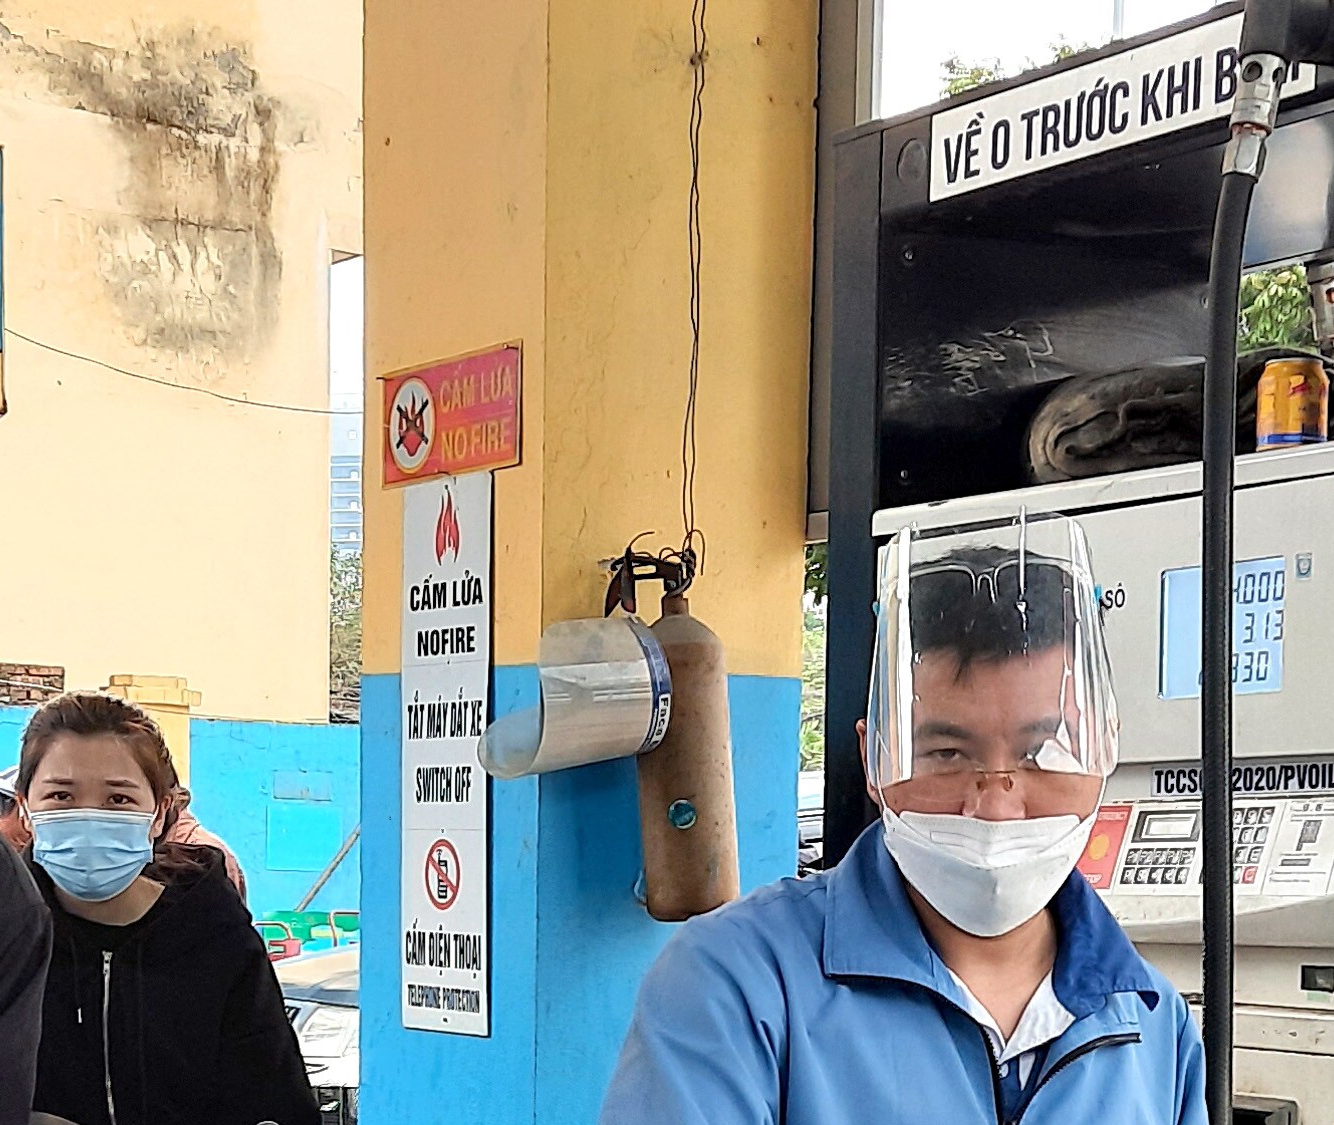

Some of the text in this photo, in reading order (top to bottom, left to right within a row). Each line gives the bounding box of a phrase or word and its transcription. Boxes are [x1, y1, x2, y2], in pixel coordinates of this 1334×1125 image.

[943, 111, 985, 185] VỀ
[1020, 77, 1130, 162] TRƯỚC
[1140, 56, 1203, 127] KHI
[441, 416, 512, 463] NO FIRE
[409, 569, 483, 612] CẤM LỬA
[417, 625, 476, 657] NOFIRE
[407, 690, 425, 740] TẮT
[426, 694, 449, 740] MÁY
[469, 699, 483, 738] XE
[415, 765, 472, 804] SWITCH OFF
[1154, 768, 1203, 794] TCCS
[405, 918, 426, 967] CẤM
[453, 933, 482, 980] THOẠI
